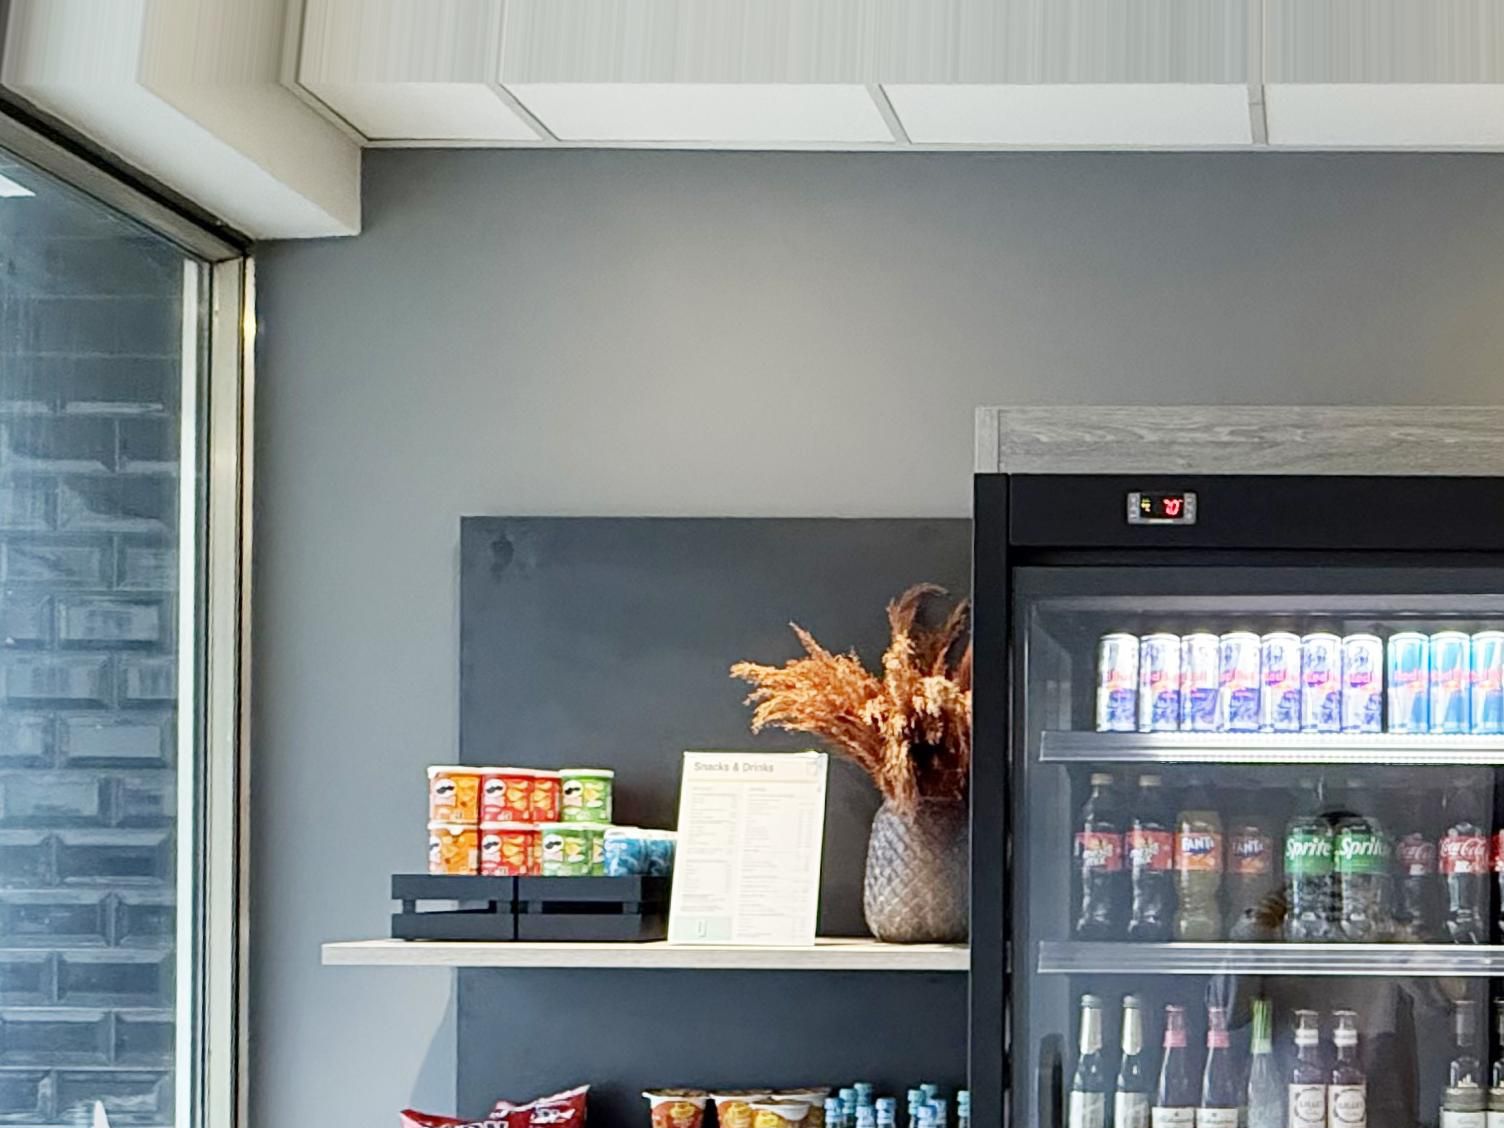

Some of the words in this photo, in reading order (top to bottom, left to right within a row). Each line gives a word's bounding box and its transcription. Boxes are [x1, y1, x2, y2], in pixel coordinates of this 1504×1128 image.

[694, 761, 729, 772] Snacks
[732, 762, 739, 772] &
[742, 762, 774, 773] Drinks
[1286, 837, 1332, 859] Sprite
